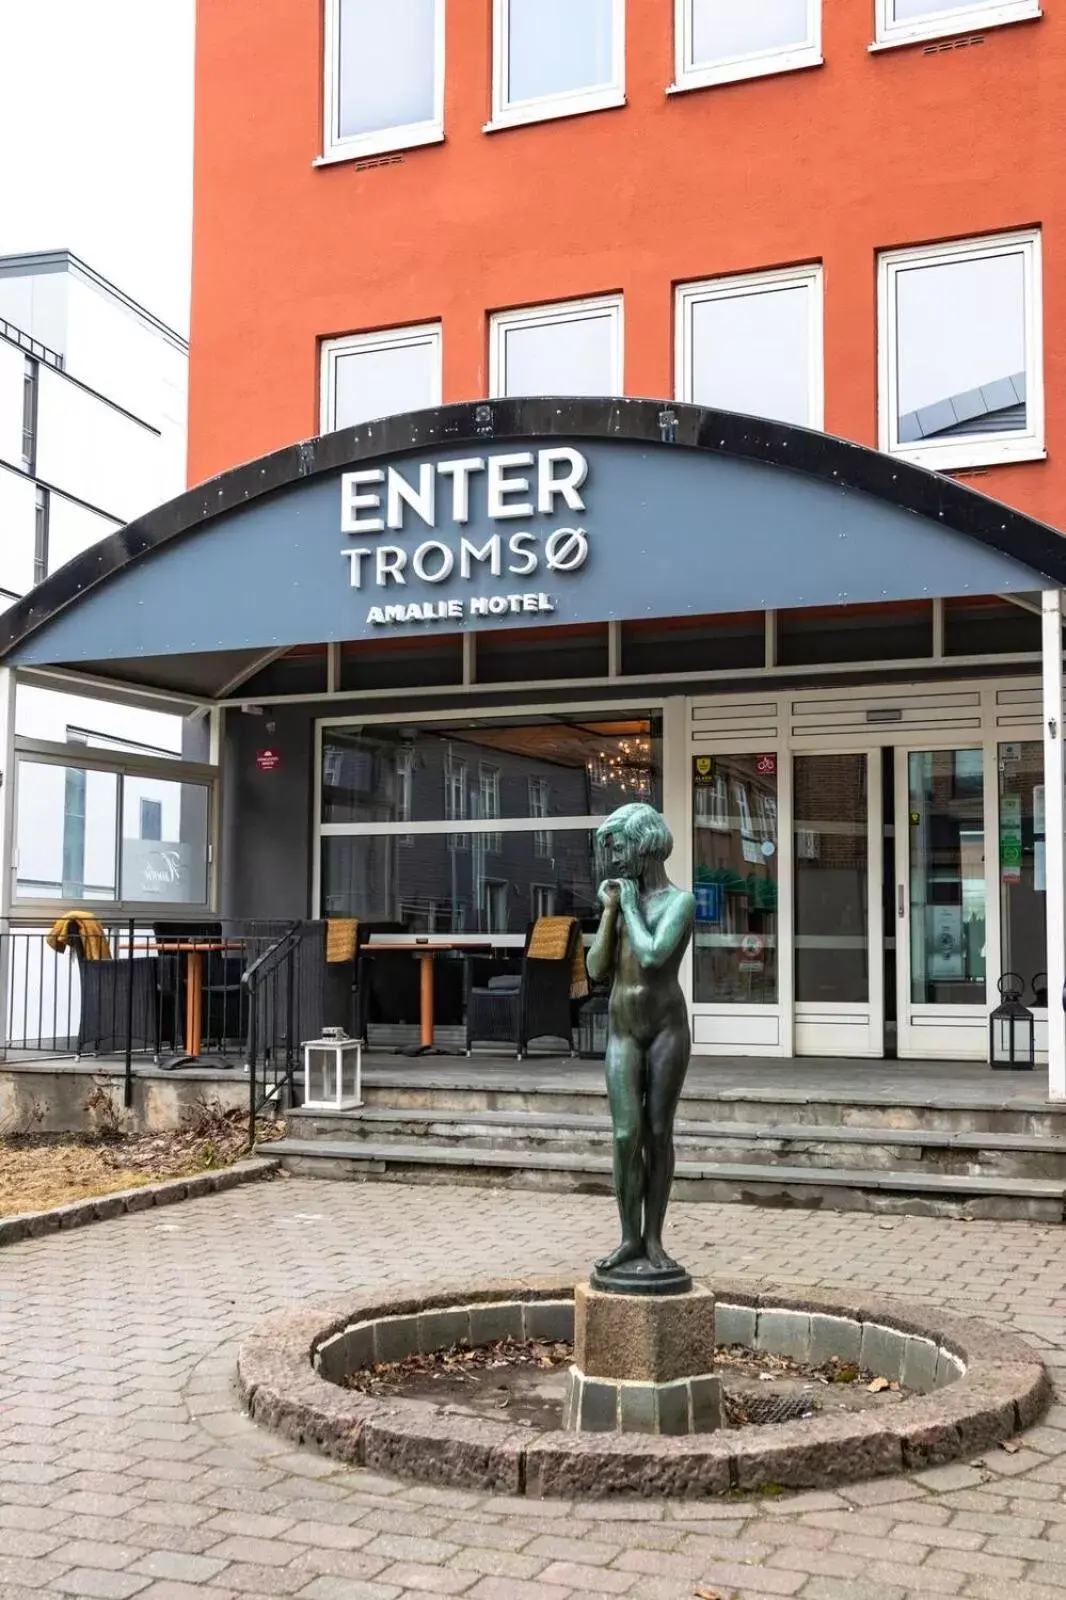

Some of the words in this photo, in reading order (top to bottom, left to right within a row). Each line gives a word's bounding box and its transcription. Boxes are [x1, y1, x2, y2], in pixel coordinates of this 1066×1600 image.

[341, 447, 588, 534] ENTER
[341, 527, 588, 588] TROMSØ
[366, 599, 463, 624] AMALIE
[470, 592, 554, 616] HOTEL
